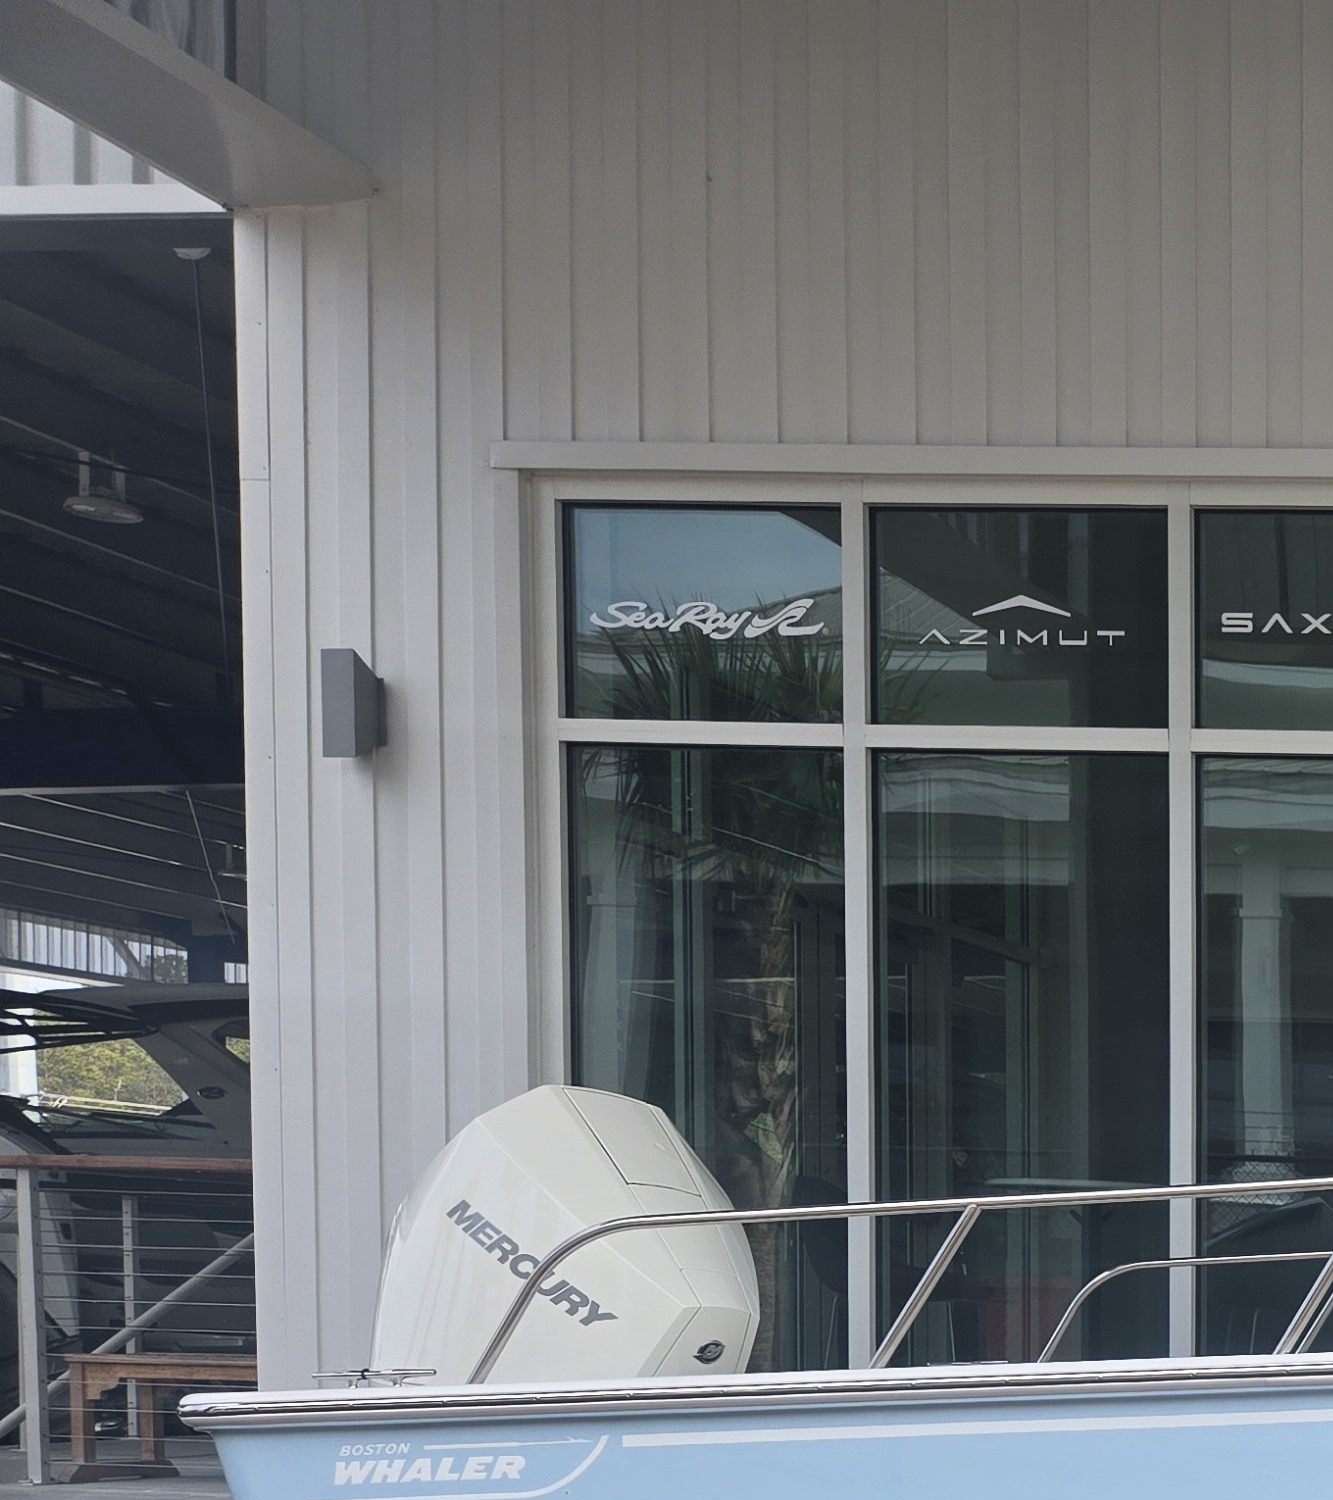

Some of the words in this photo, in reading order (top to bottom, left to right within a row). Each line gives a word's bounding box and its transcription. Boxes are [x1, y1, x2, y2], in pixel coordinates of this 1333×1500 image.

[589, 601, 674, 630] Sea
[668, 601, 752, 640] Ray
[919, 628, 1126, 646] AZIMUT
[445, 1198, 619, 1327] MERCURY
[338, 1442, 411, 1458] BOSTON
[334, 1455, 526, 1486] WHALER
